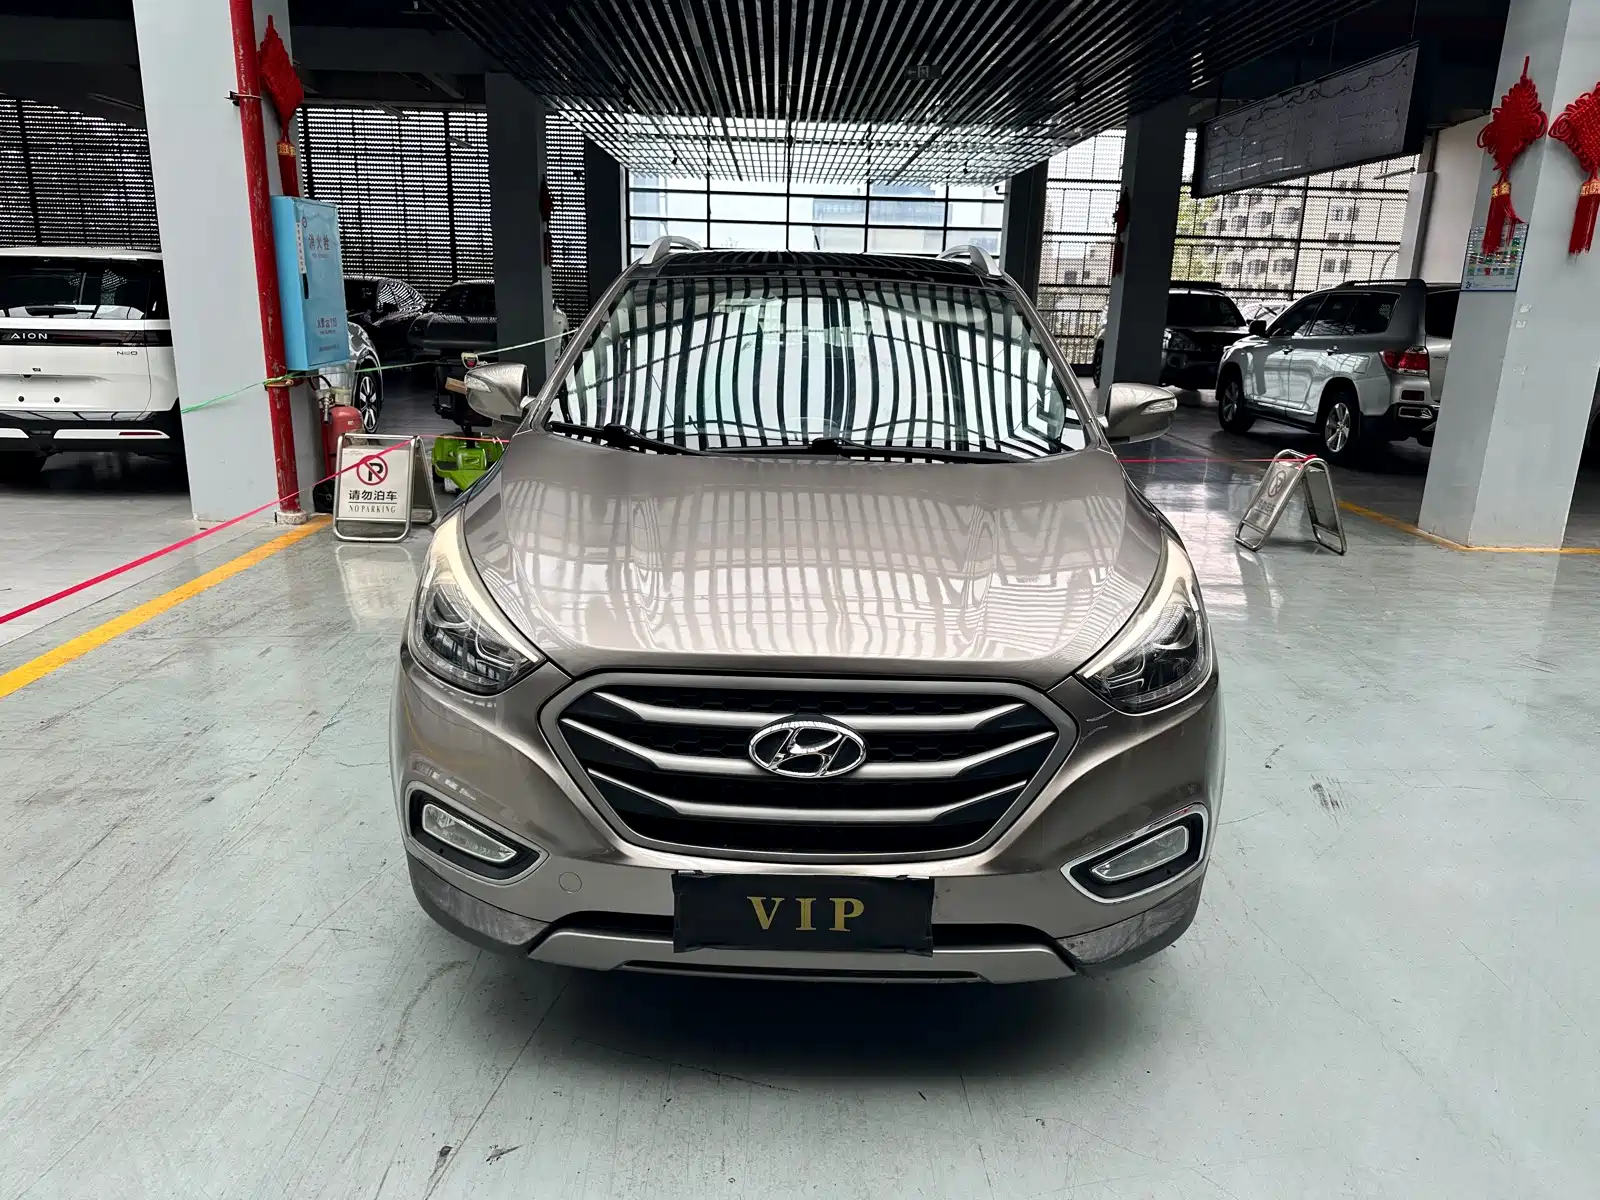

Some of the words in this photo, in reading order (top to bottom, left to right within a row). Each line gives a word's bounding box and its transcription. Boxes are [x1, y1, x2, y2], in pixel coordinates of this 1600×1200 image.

[11, 332, 48, 340] AION
[348, 489, 398, 501] 请勿泊车
[348, 504, 359, 513] NO
[361, 504, 396, 513] PARKING
[746, 896, 865, 932] VIP
